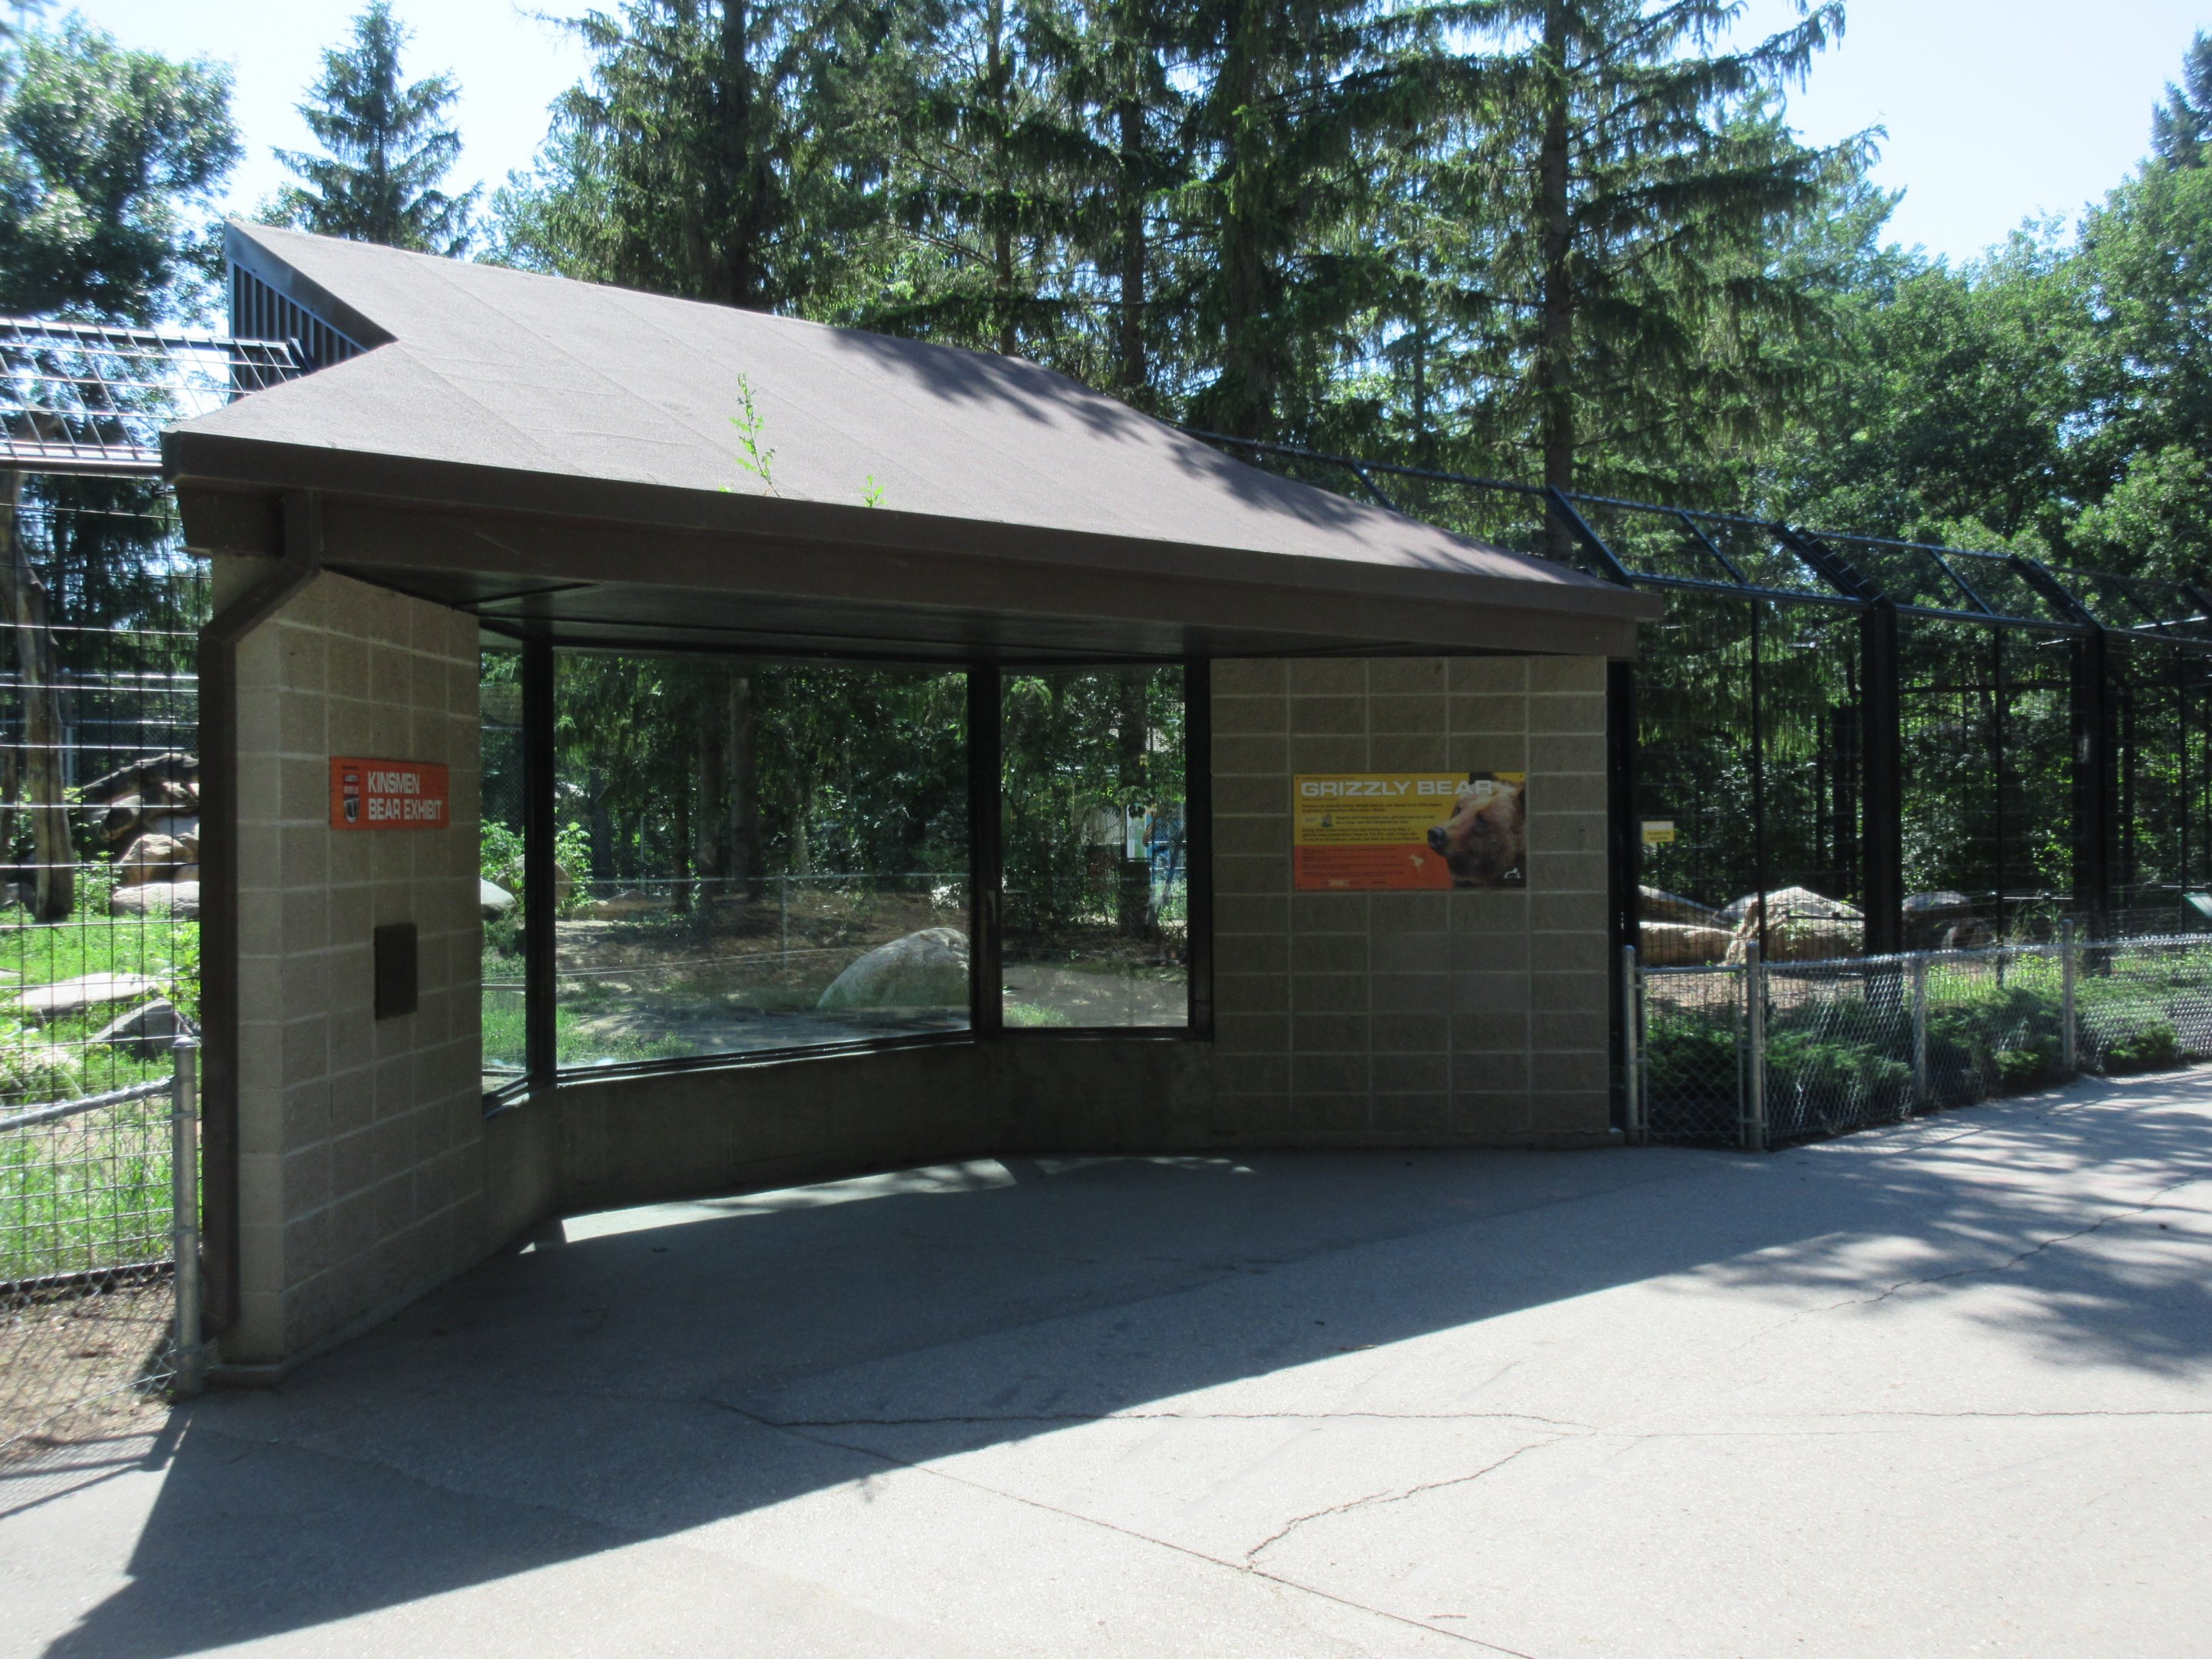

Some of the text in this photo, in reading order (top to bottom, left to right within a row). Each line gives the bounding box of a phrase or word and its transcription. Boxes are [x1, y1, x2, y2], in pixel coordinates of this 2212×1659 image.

[368, 771, 420, 794] KINSMEN
[1301, 780, 1493, 796] GRIZZLY BEAR
[368, 798, 442, 821] BEAR EXHIBIT
